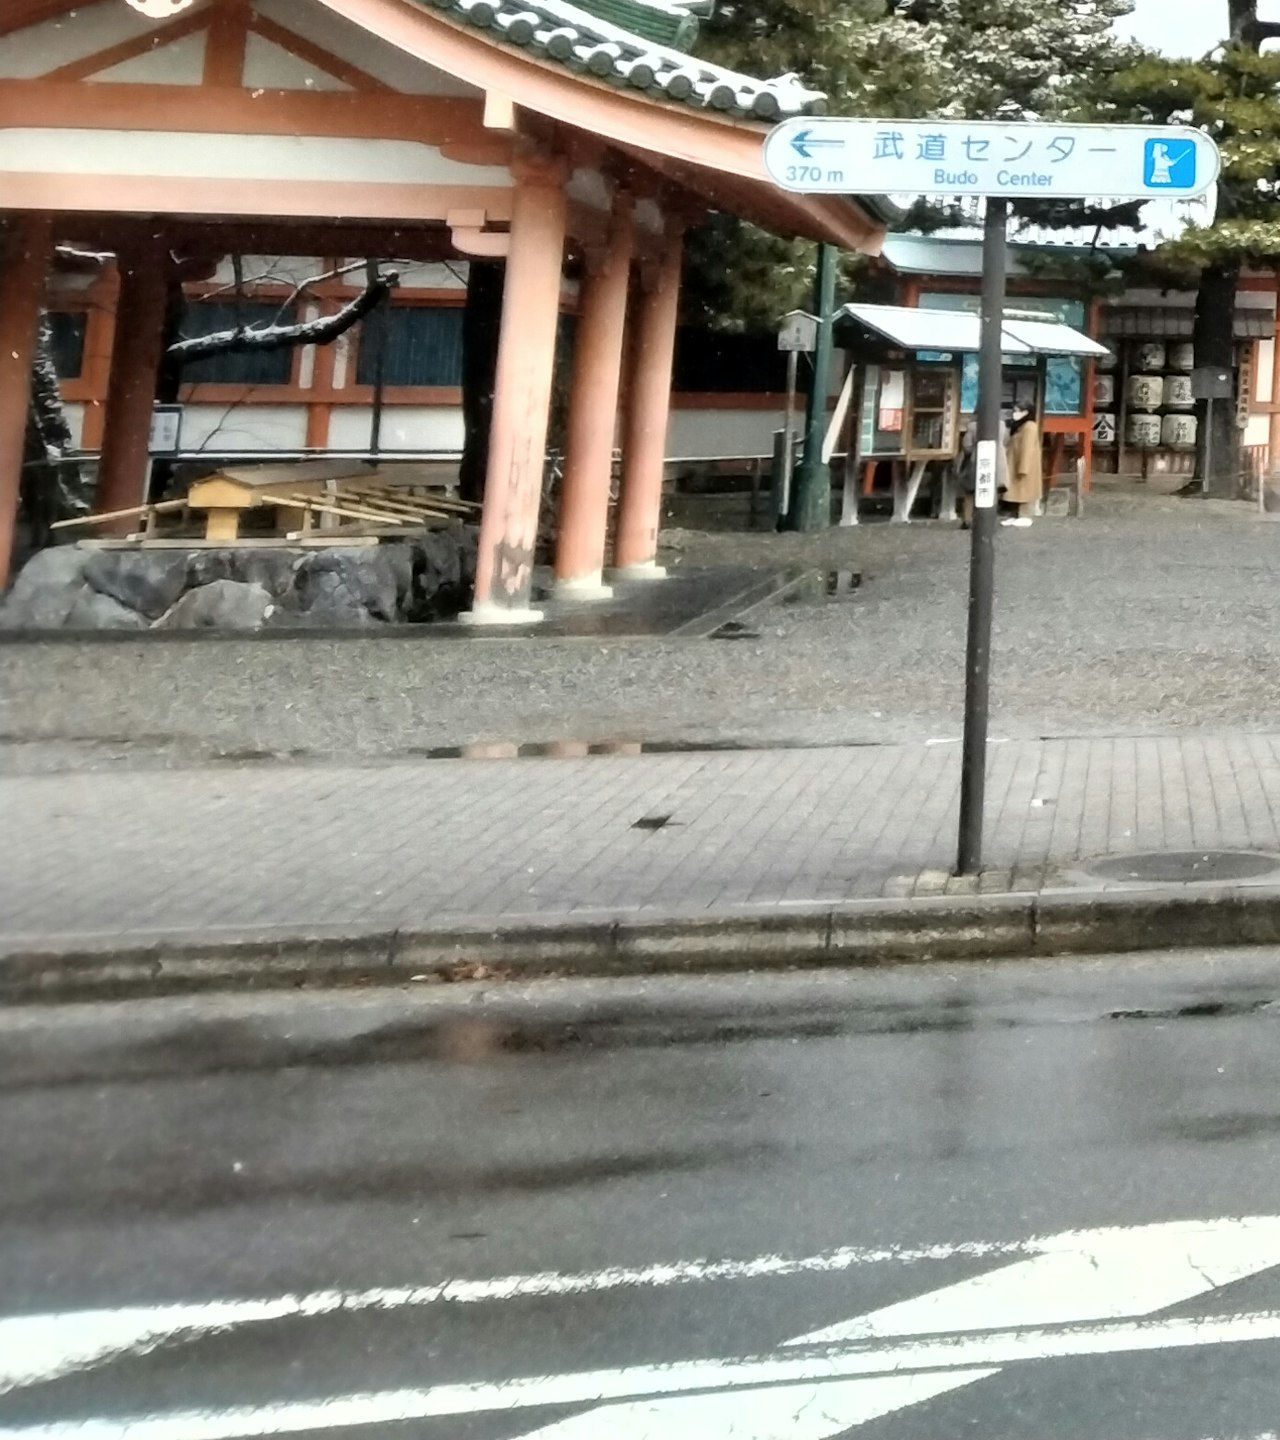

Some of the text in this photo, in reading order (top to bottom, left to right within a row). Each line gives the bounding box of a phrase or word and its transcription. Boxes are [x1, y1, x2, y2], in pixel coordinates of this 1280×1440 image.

[872, 130, 1118, 163] 武道センター
[785, 166, 844, 183] 370 m
[933, 168, 1054, 187] Budo Center
[978, 457, 992, 498] 京都市
